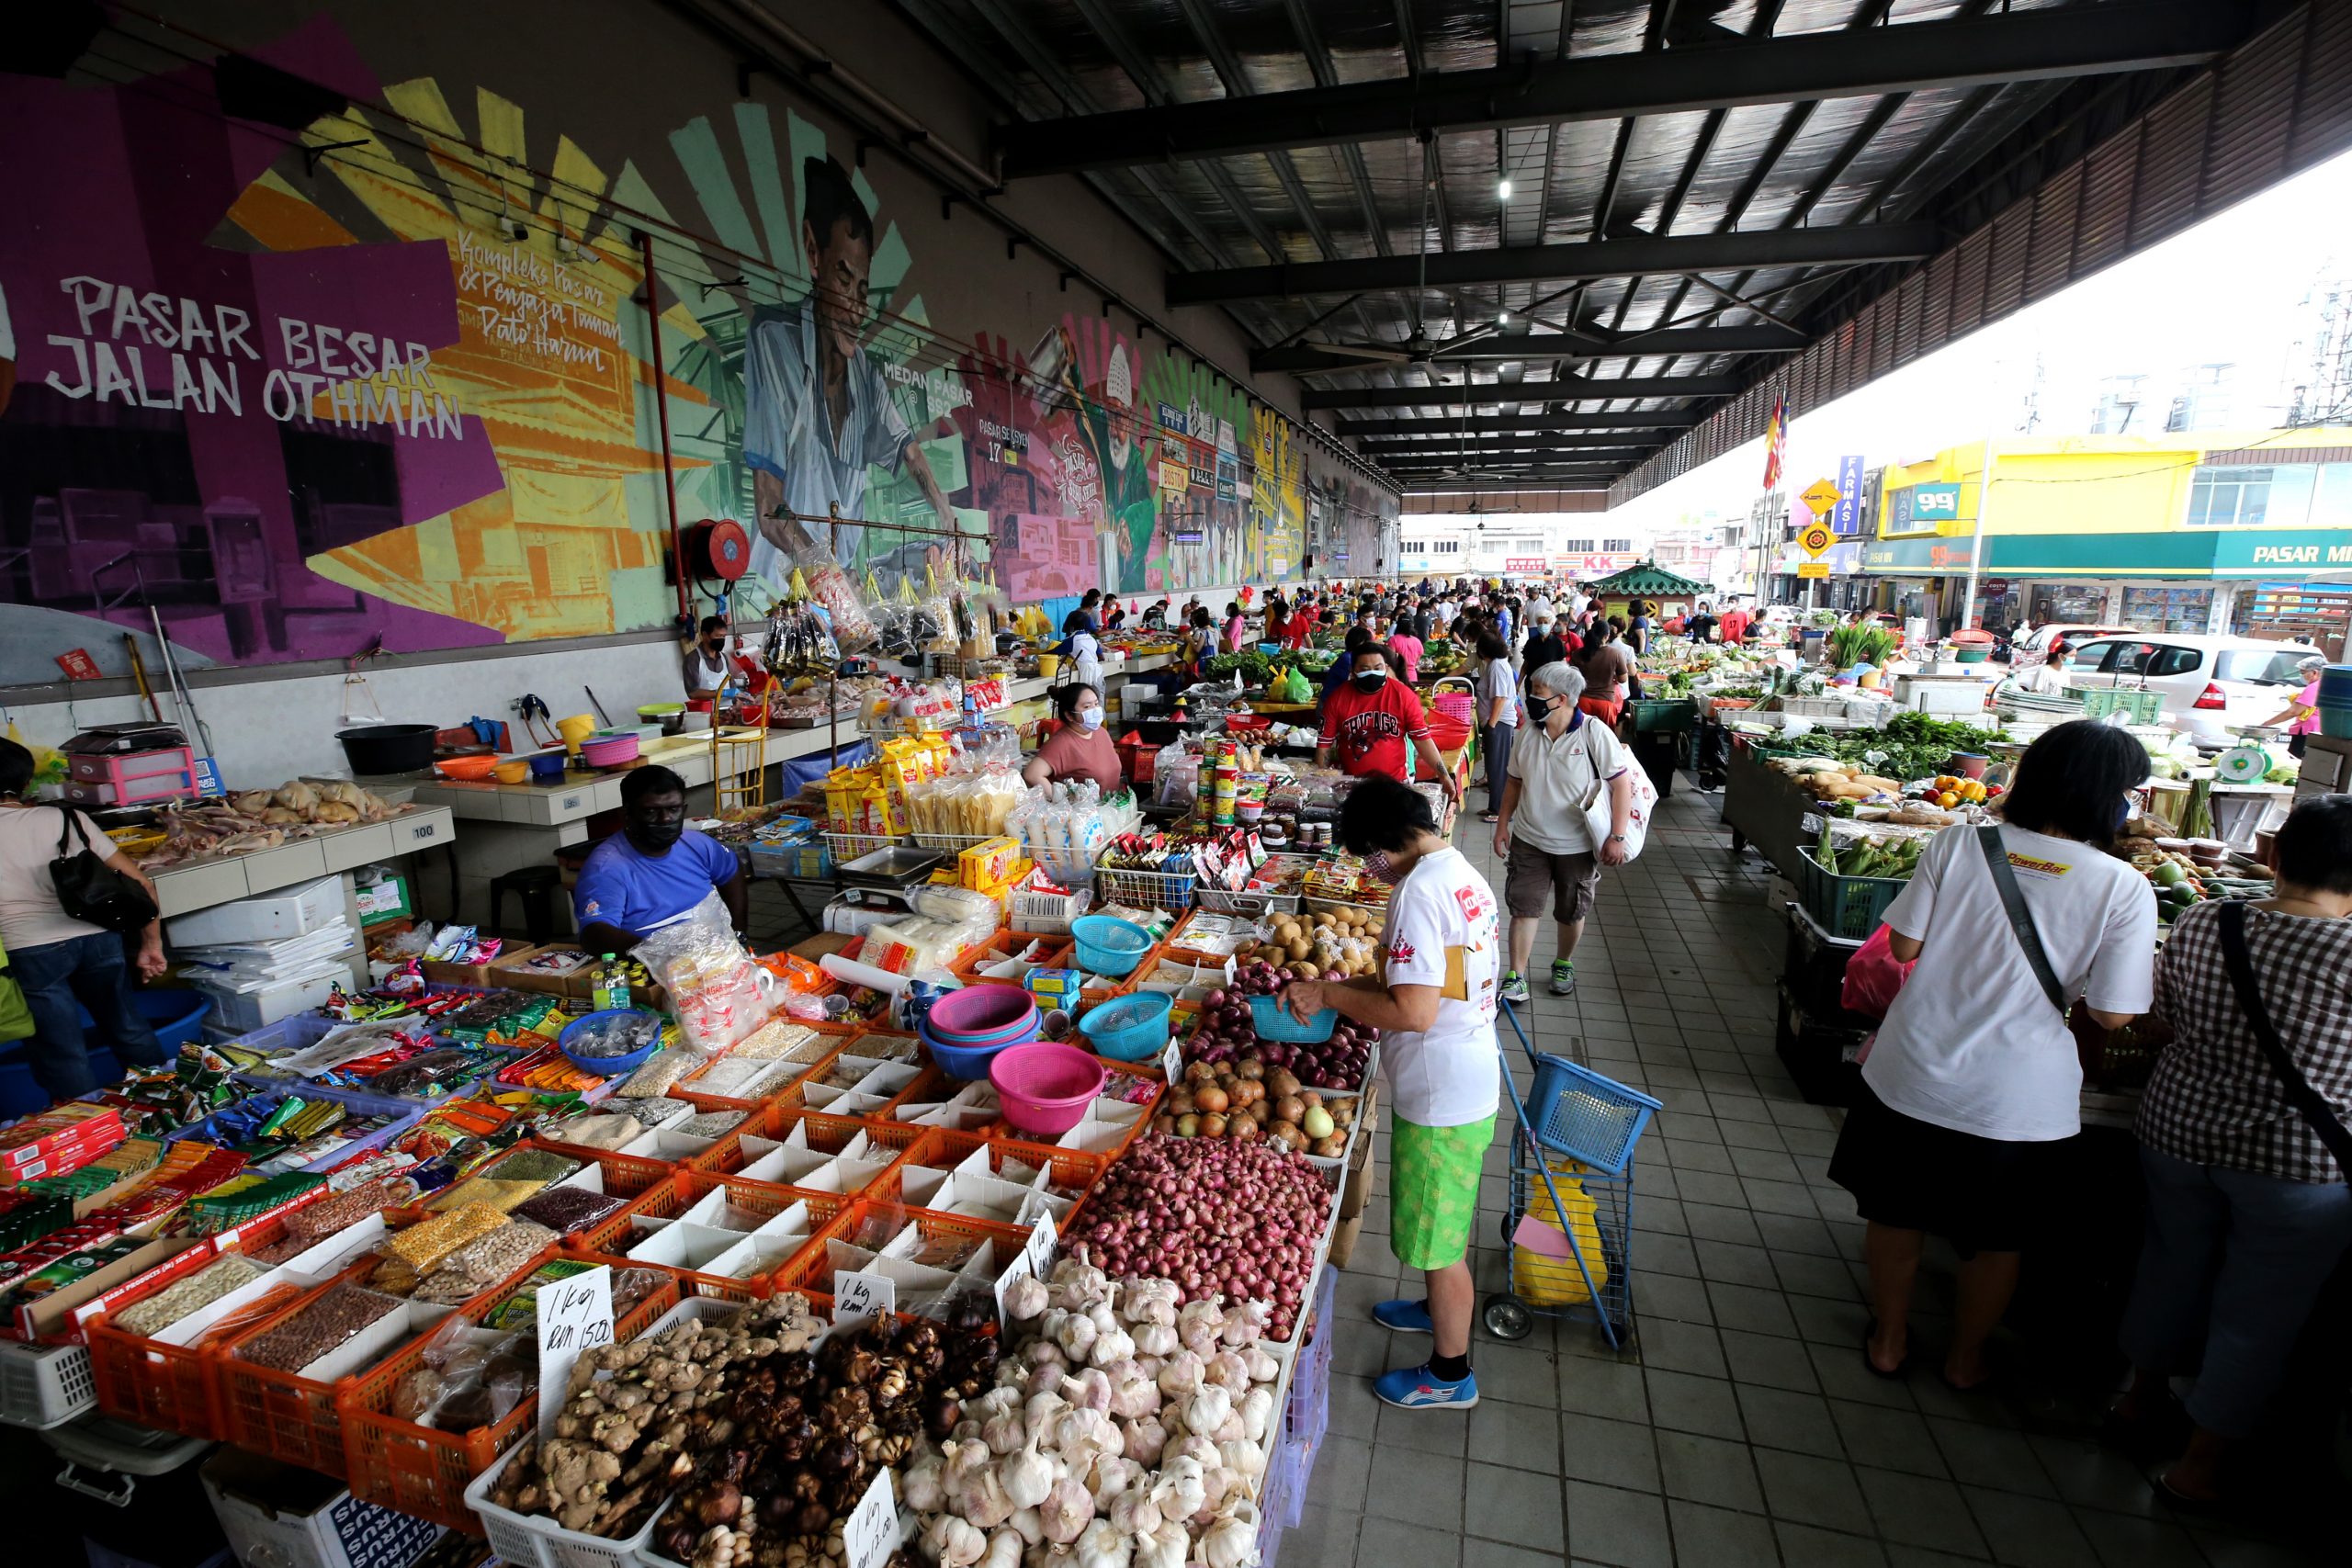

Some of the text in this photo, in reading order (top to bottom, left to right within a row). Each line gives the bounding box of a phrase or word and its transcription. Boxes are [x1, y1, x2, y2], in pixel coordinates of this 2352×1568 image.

[458, 230, 605, 308] Kompleks Pasar
[459, 264, 626, 348] & Penjaja Taman
[61, 276, 435, 388] PASAR BESAR
[532, 323, 605, 372] Harun
[45, 334, 463, 440] JALAN OTHMAN
[884, 362, 975, 408] MEDAN PASAR
[908, 390, 953, 419] @ SS2
[978, 419, 1029, 447] PASAR SEKSYEN
[988, 441, 1001, 463] 17
[1064, 452, 1089, 479] PASAR
[1164, 469, 1185, 491] BOSTON
[1841, 457, 1858, 533] FARMASI
[1917, 491, 1956, 512] 99
[1584, 556, 1612, 569] KK
[2253, 546, 2352, 563] PASAR MI
[1729, 620, 1736, 628] 17
[414, 826, 433, 839] 100
[2007, 852, 2066, 874] PowerBar
[238, 1221, 256, 1233] BABA
[256, 1206, 287, 1224] PRODUCTS
[104, 1287, 126, 1302] BABA
[126, 1269, 161, 1292] PRODUCTS
